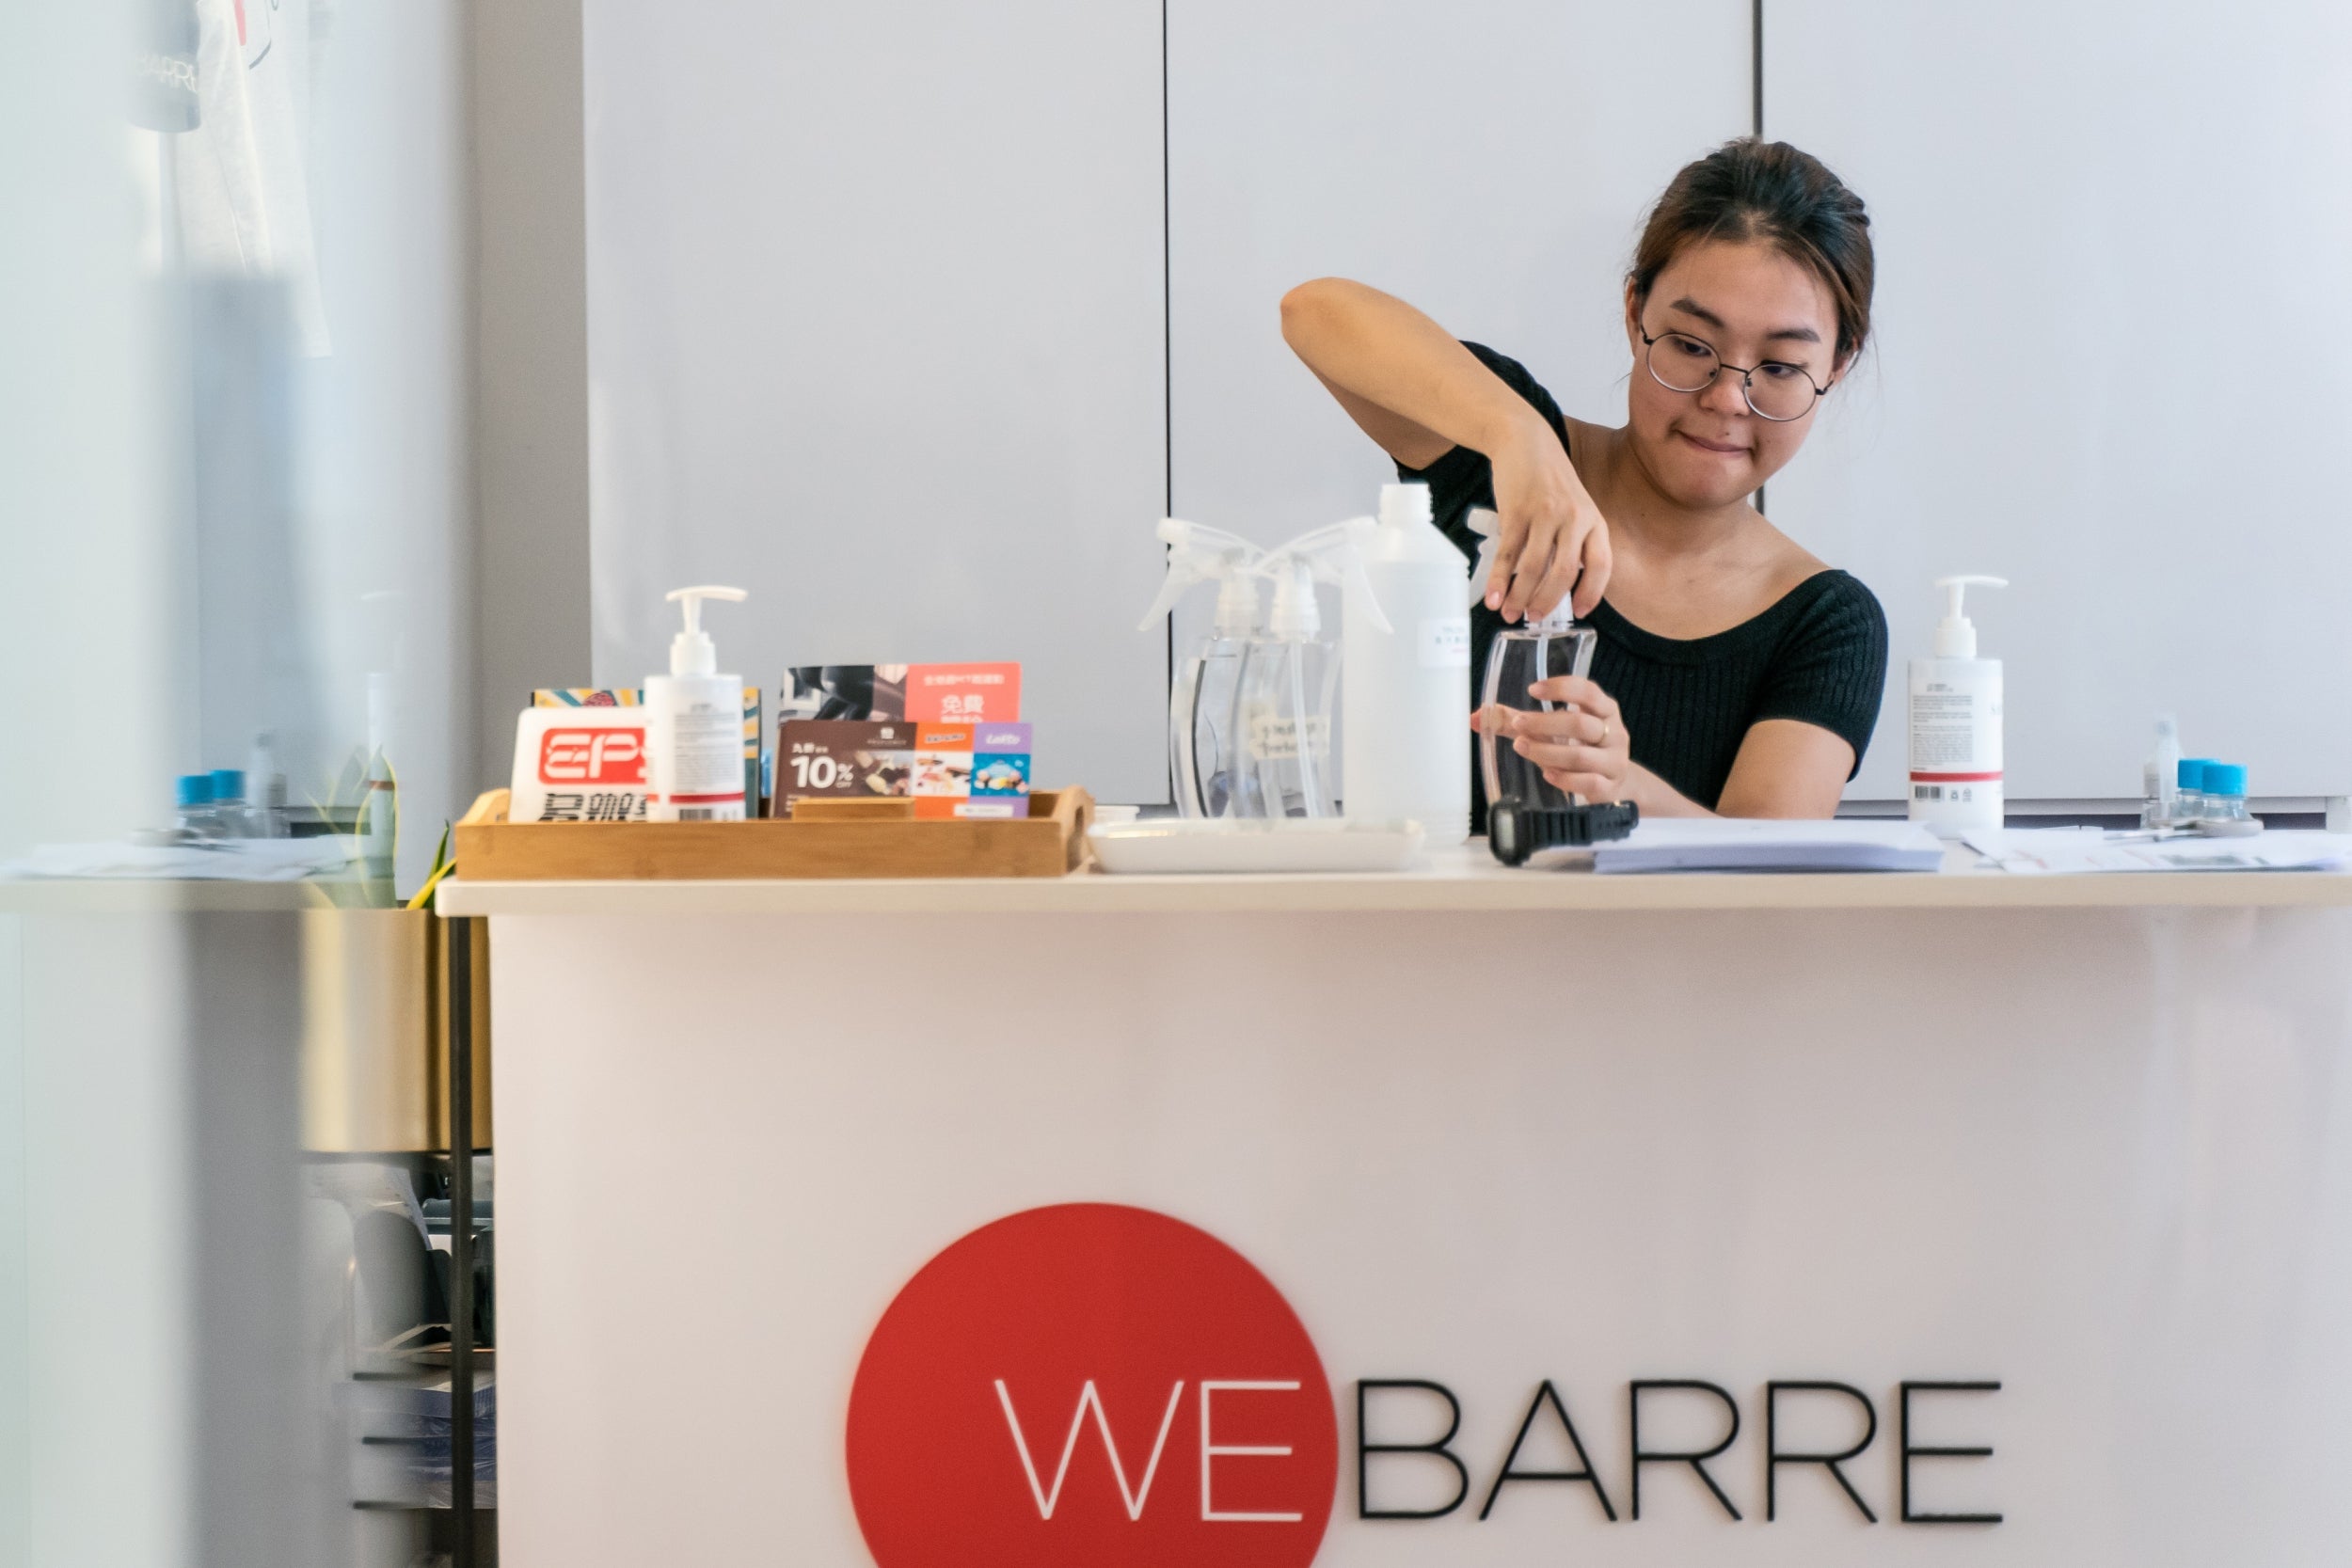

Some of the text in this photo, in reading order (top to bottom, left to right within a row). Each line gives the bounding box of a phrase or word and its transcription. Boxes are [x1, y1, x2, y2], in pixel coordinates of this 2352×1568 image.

[940, 694, 985, 715] 免費
[544, 734, 647, 779] EP
[790, 755, 854, 789] 10%
[994, 1379, 2004, 1523] WE BARRE
